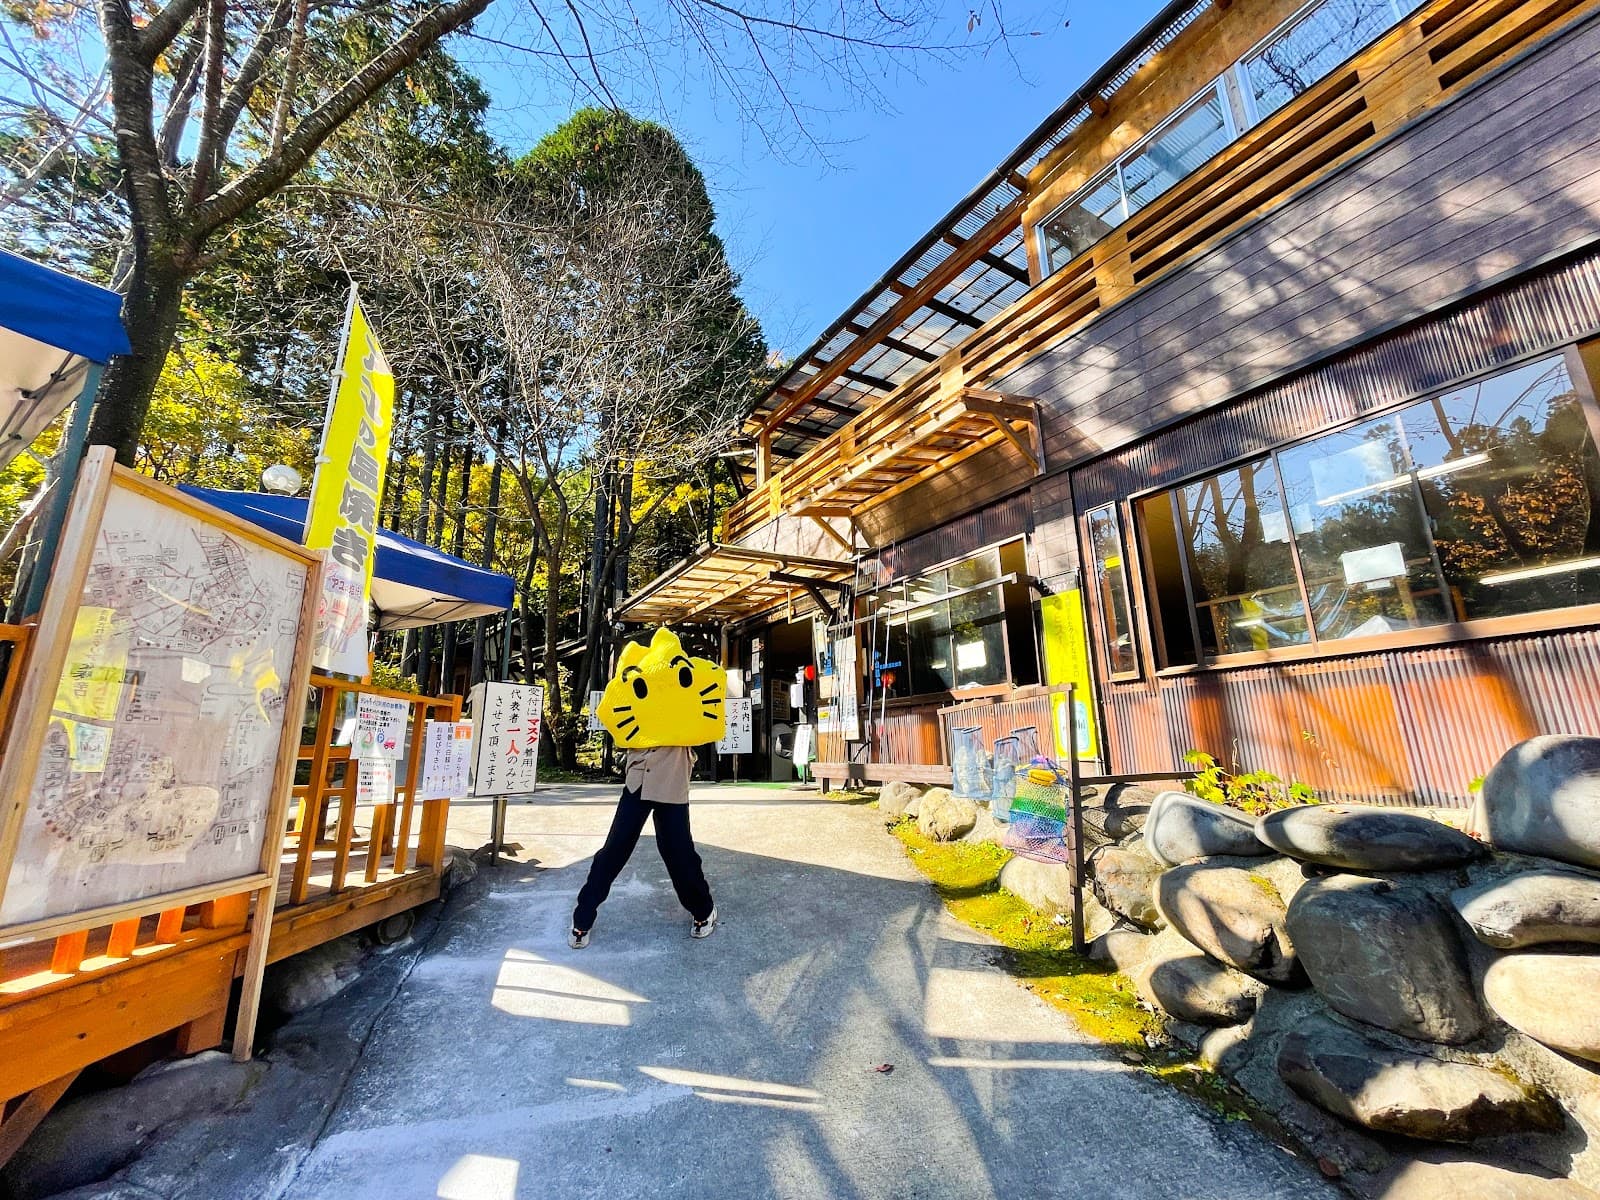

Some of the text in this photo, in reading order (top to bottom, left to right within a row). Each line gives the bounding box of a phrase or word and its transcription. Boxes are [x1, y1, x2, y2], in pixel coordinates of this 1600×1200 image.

[485, 695, 503, 790] させて頂きます
[505, 688, 522, 790] 代表者一人のみと
[519, 687, 541, 789] 受付はマスク着用にて
[741, 701, 750, 733] 店内は
